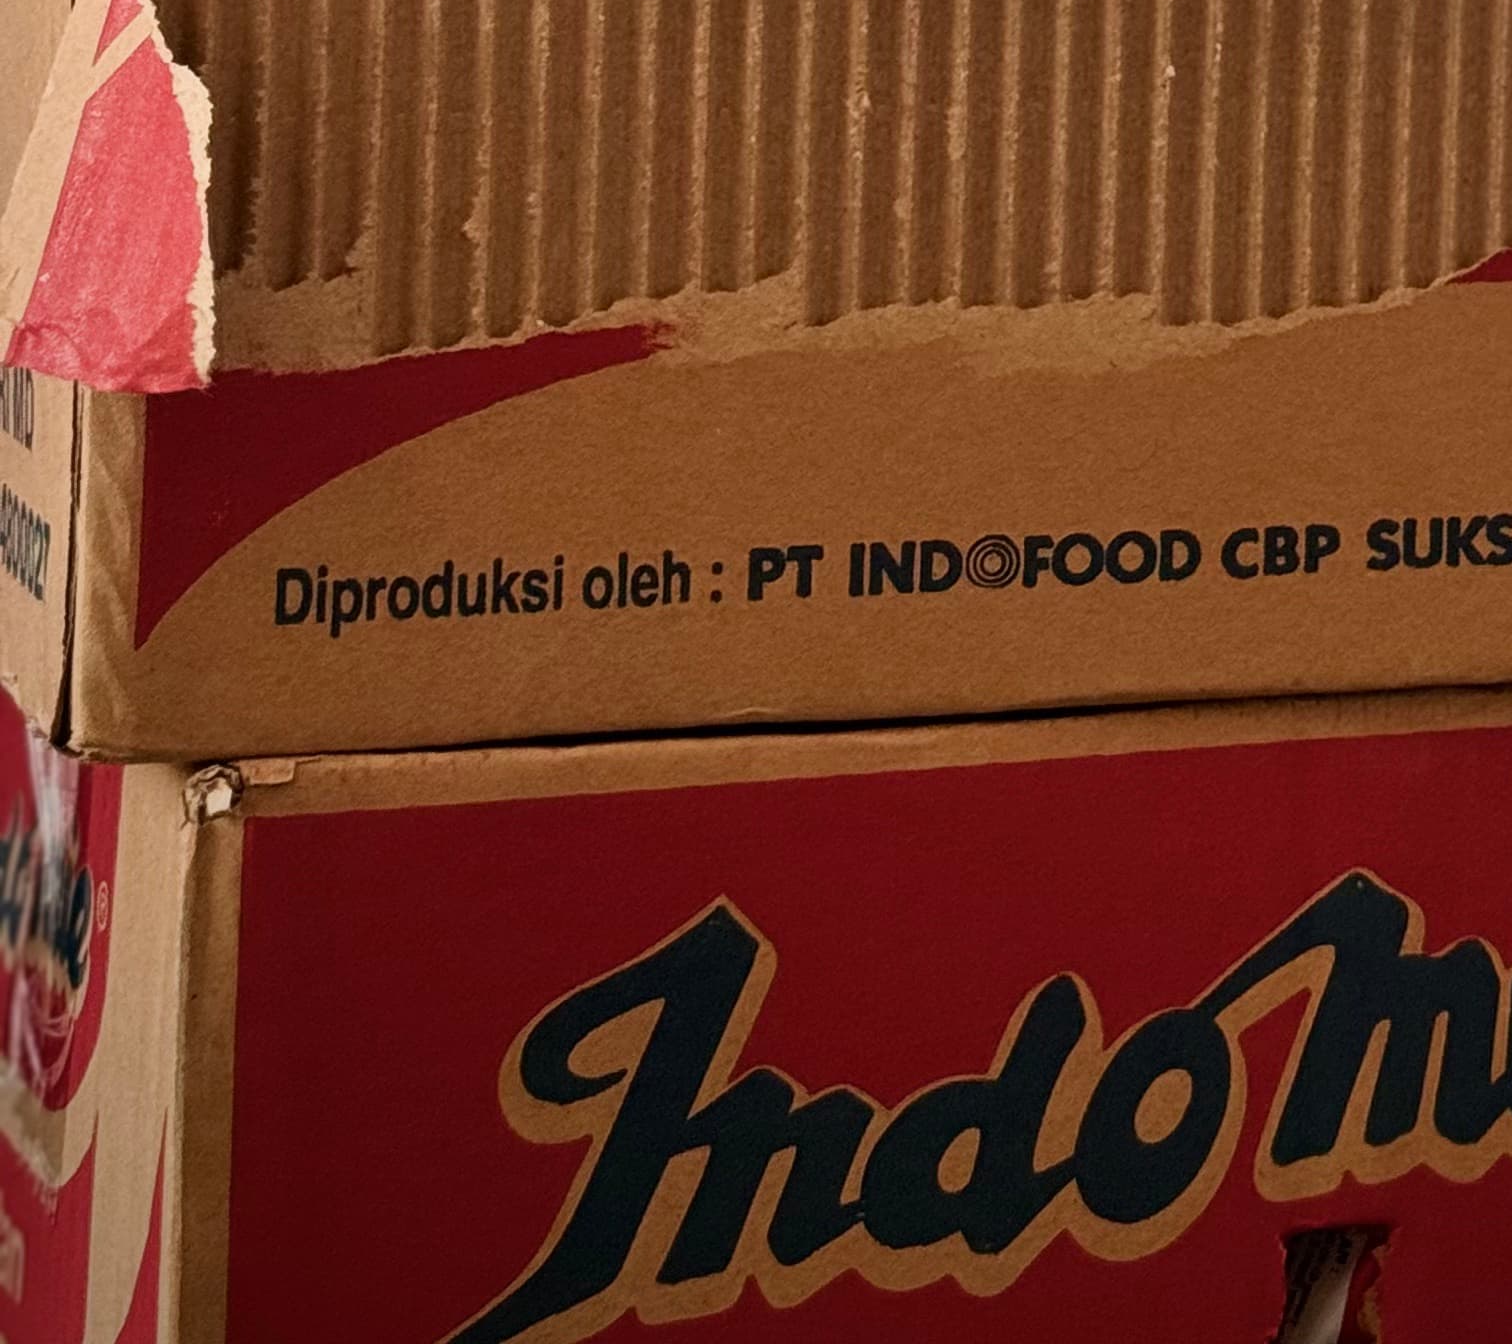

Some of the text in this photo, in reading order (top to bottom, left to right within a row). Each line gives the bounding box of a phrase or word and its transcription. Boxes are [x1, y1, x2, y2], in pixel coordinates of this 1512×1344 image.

[274, 551, 564, 639] Diproduksi
[581, 550, 692, 610] oleh
[747, 544, 823, 601] PT
[1218, 522, 1341, 580] CBP
